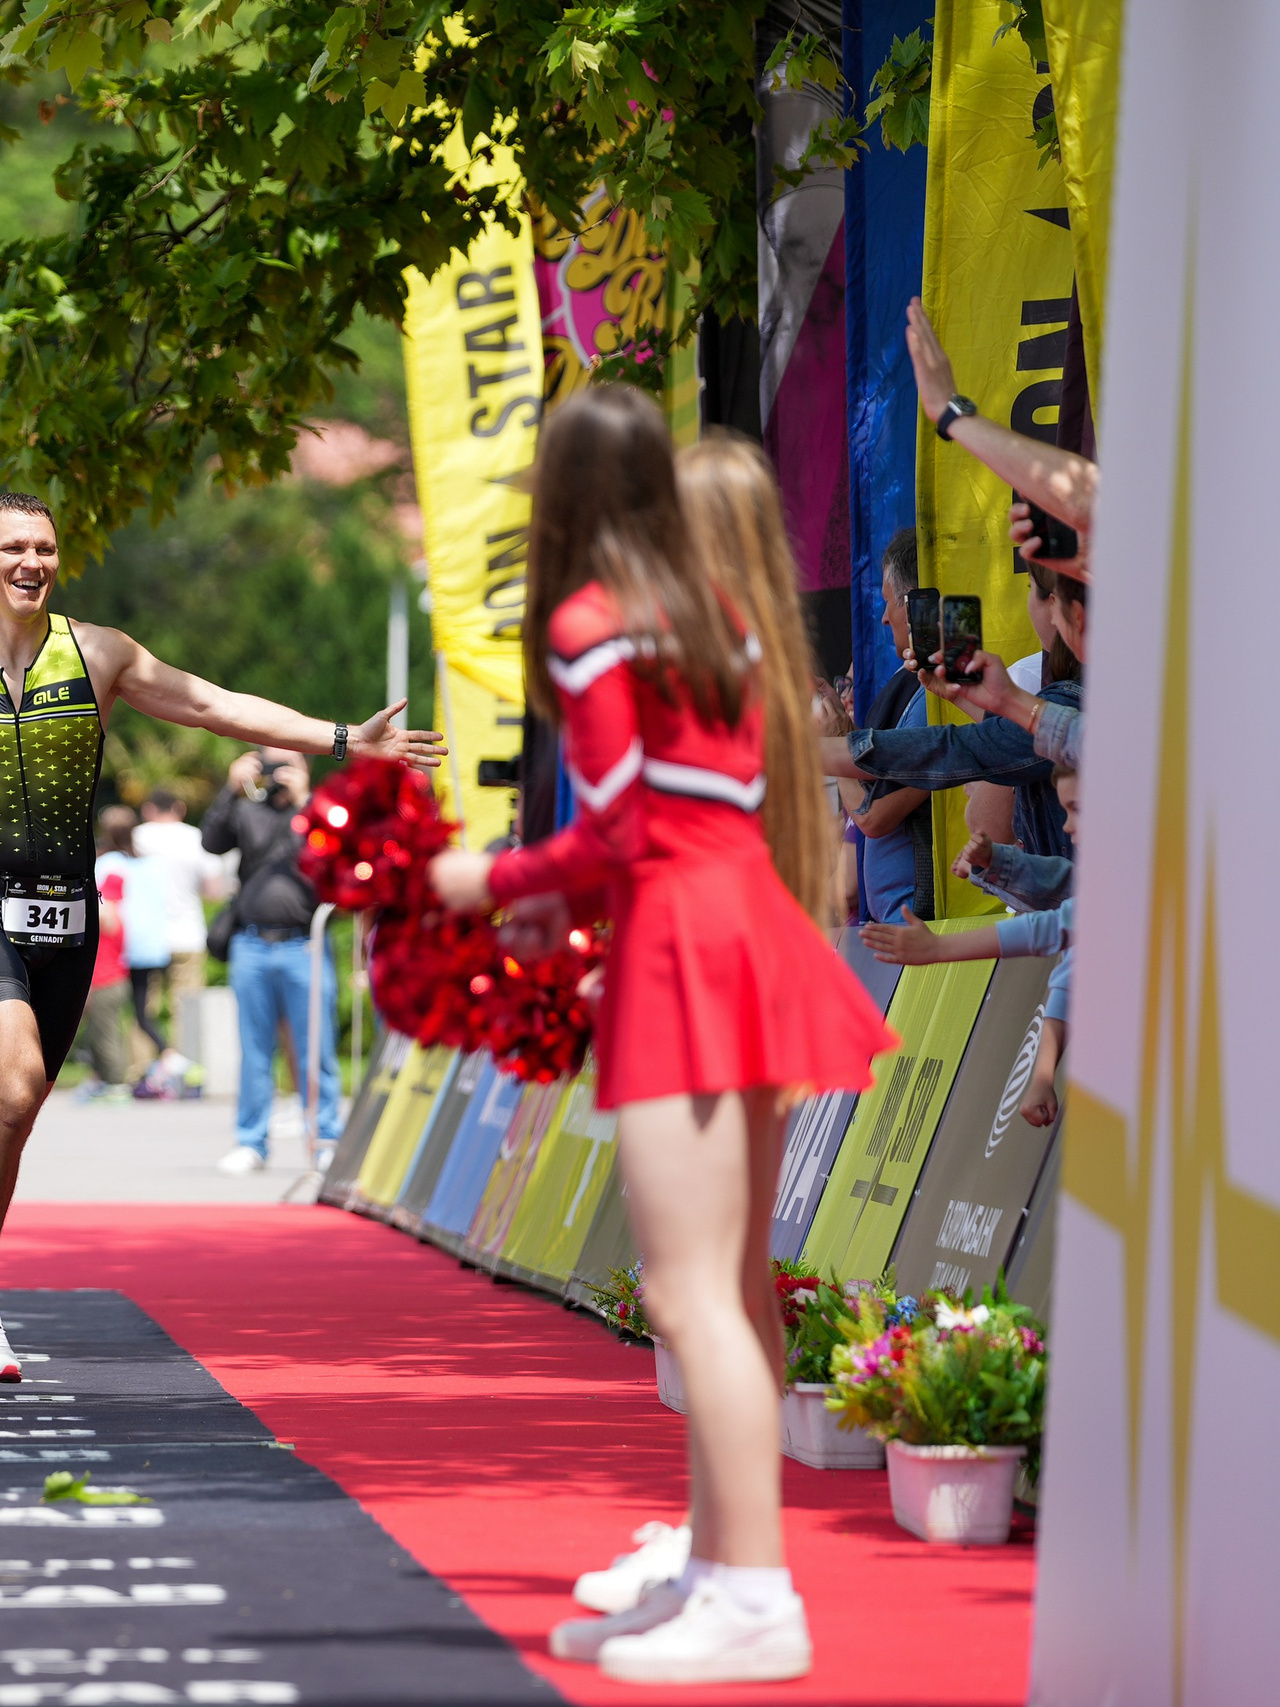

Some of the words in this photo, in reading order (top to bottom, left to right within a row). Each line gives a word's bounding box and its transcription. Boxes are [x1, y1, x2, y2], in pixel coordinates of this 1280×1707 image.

[456, 263, 541, 441] STAR
[26, 905, 70, 929] 341
[30, 935, 64, 943] GENNADIY
[889, 1057, 944, 1163] STAR
